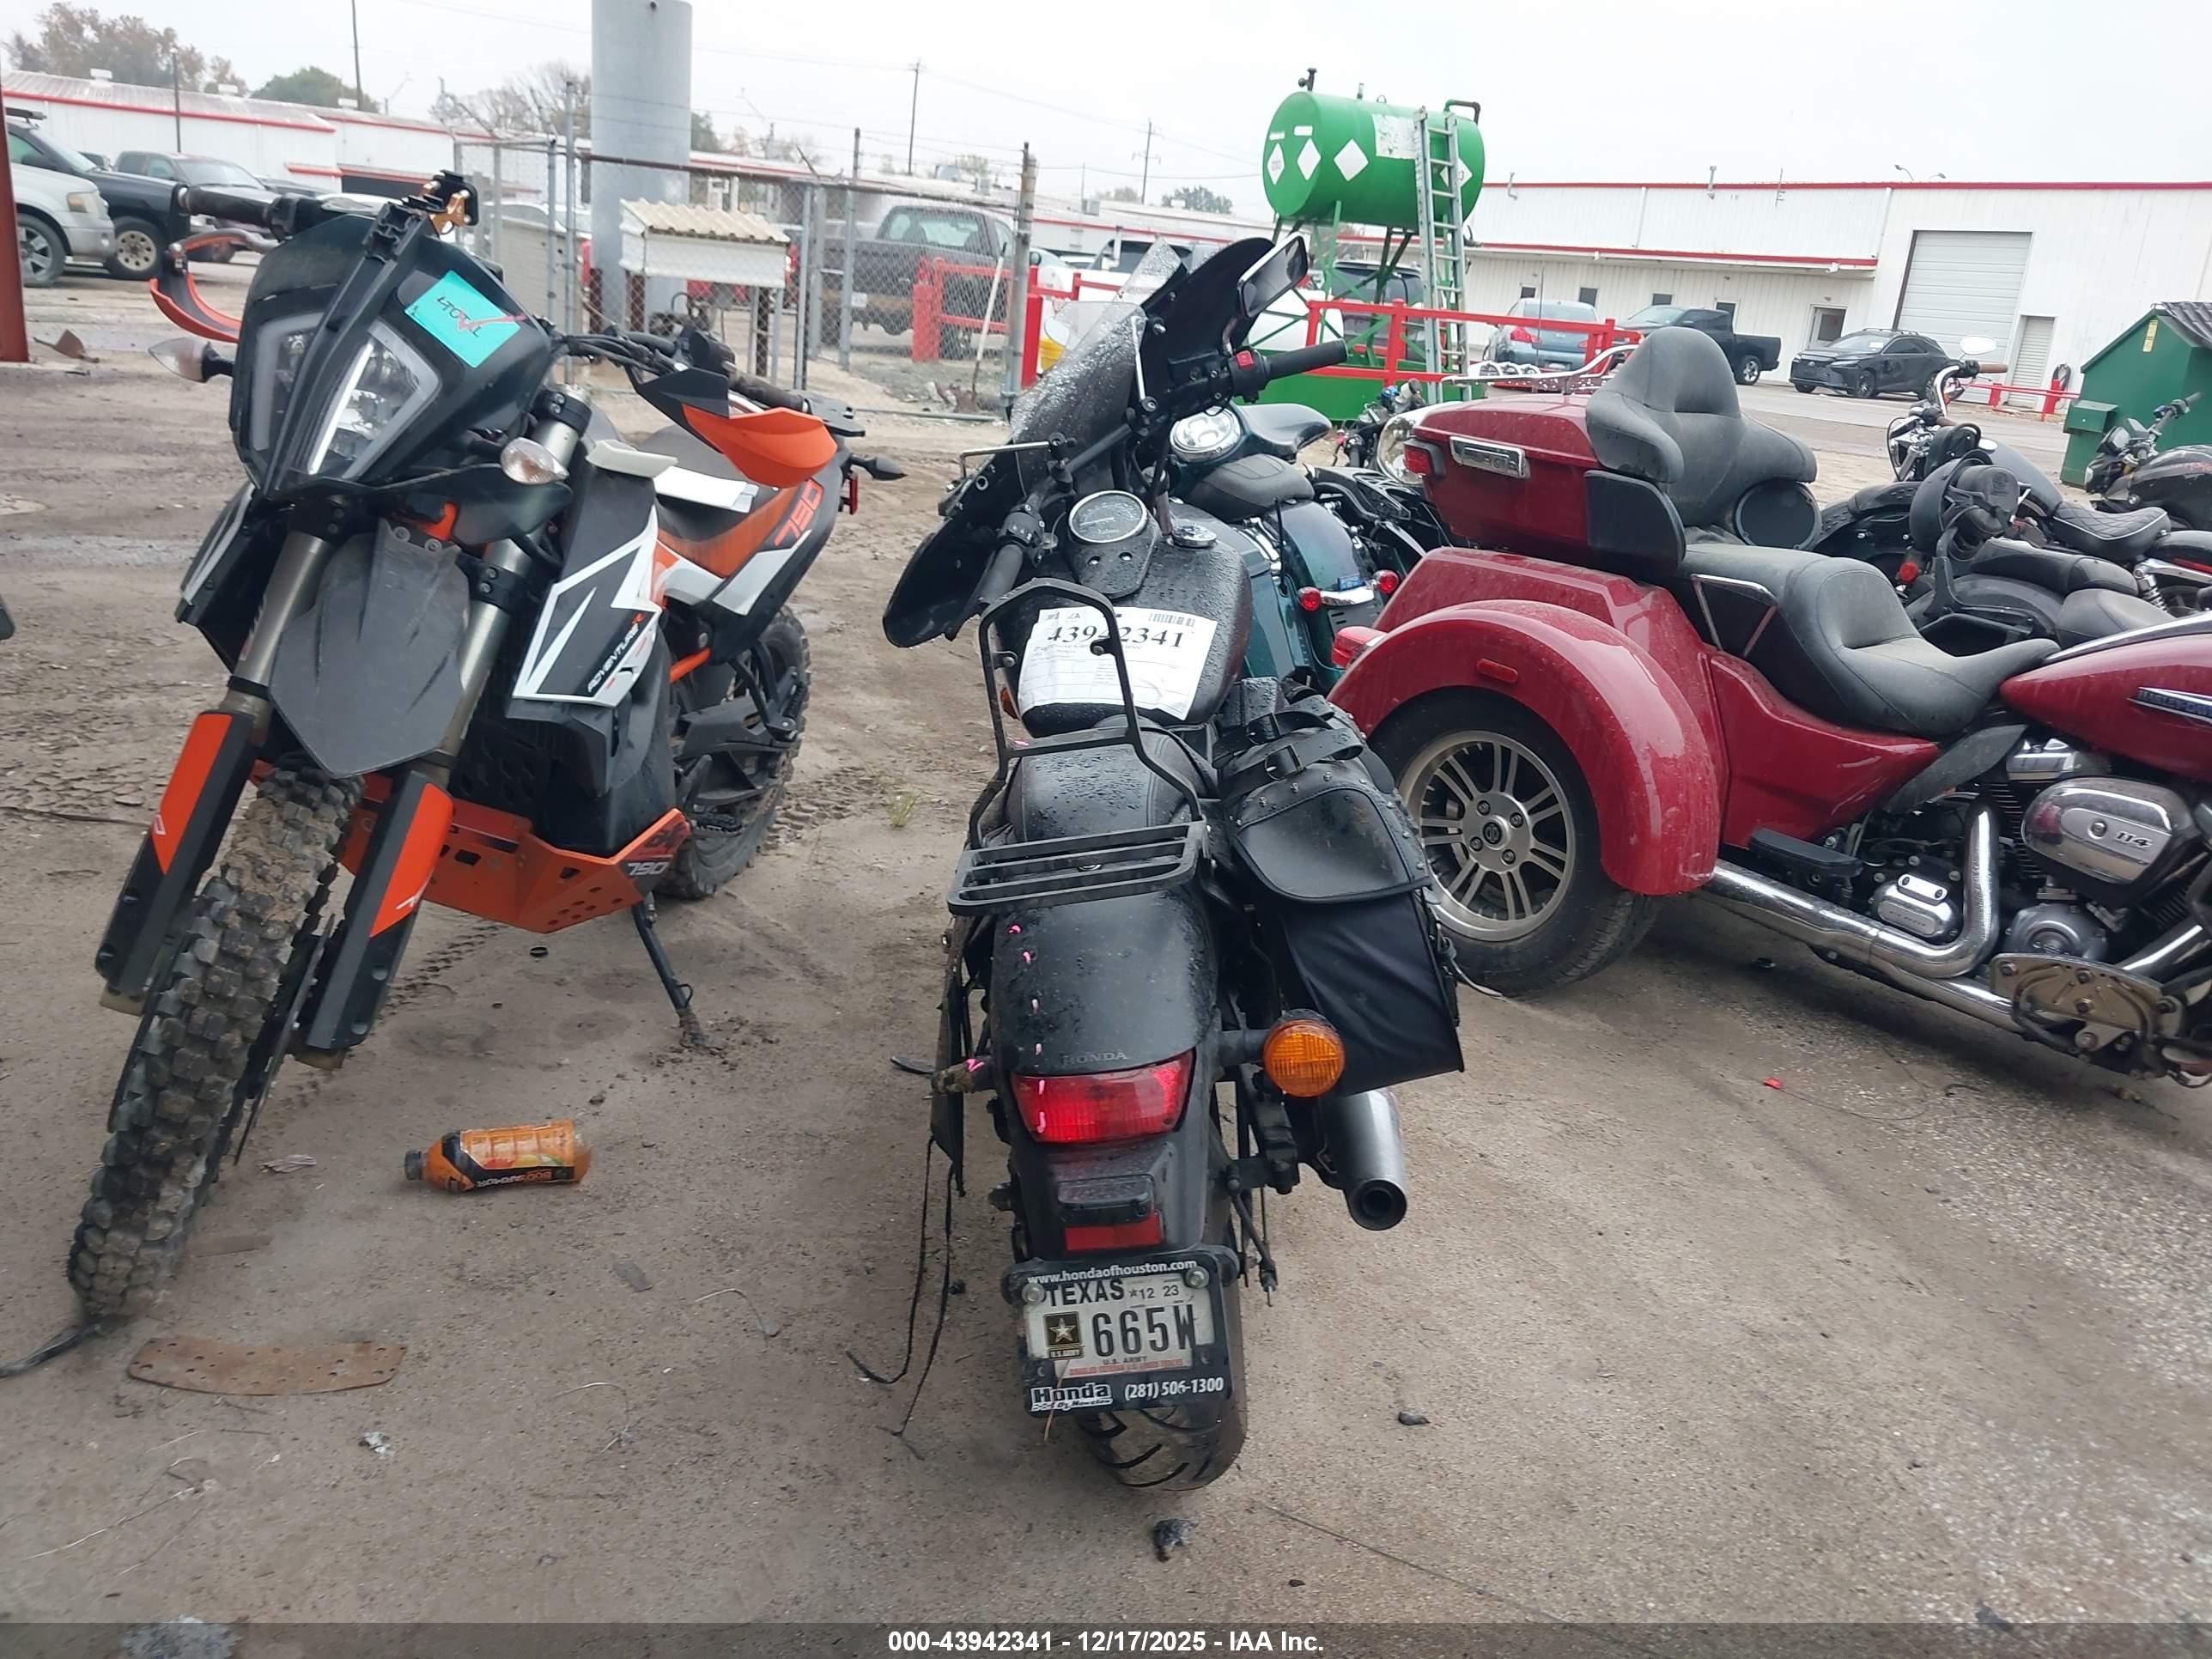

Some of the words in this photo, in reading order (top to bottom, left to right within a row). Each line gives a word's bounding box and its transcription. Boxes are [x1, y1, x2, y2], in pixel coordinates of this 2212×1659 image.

[774, 478, 823, 546] 790
[587, 623, 639, 693] ADVENTURE
[2116, 831, 2152, 848] 114
[628, 861, 670, 876] 790
[1062, 1052, 1128, 1066] HONDA
[1026, 1260, 1198, 1284] www.hondaofhouston.com
[1043, 1278, 1125, 1307] TEXAS
[1139, 1287, 1156, 1299] 12
[1163, 1285, 1180, 1297] 23
[1092, 1304, 1195, 1358] 665W
[1033, 1383, 1111, 1403] Honda
[1124, 1382, 1159, 1401] (281)
[1161, 1377, 1224, 1396] 506-1300
